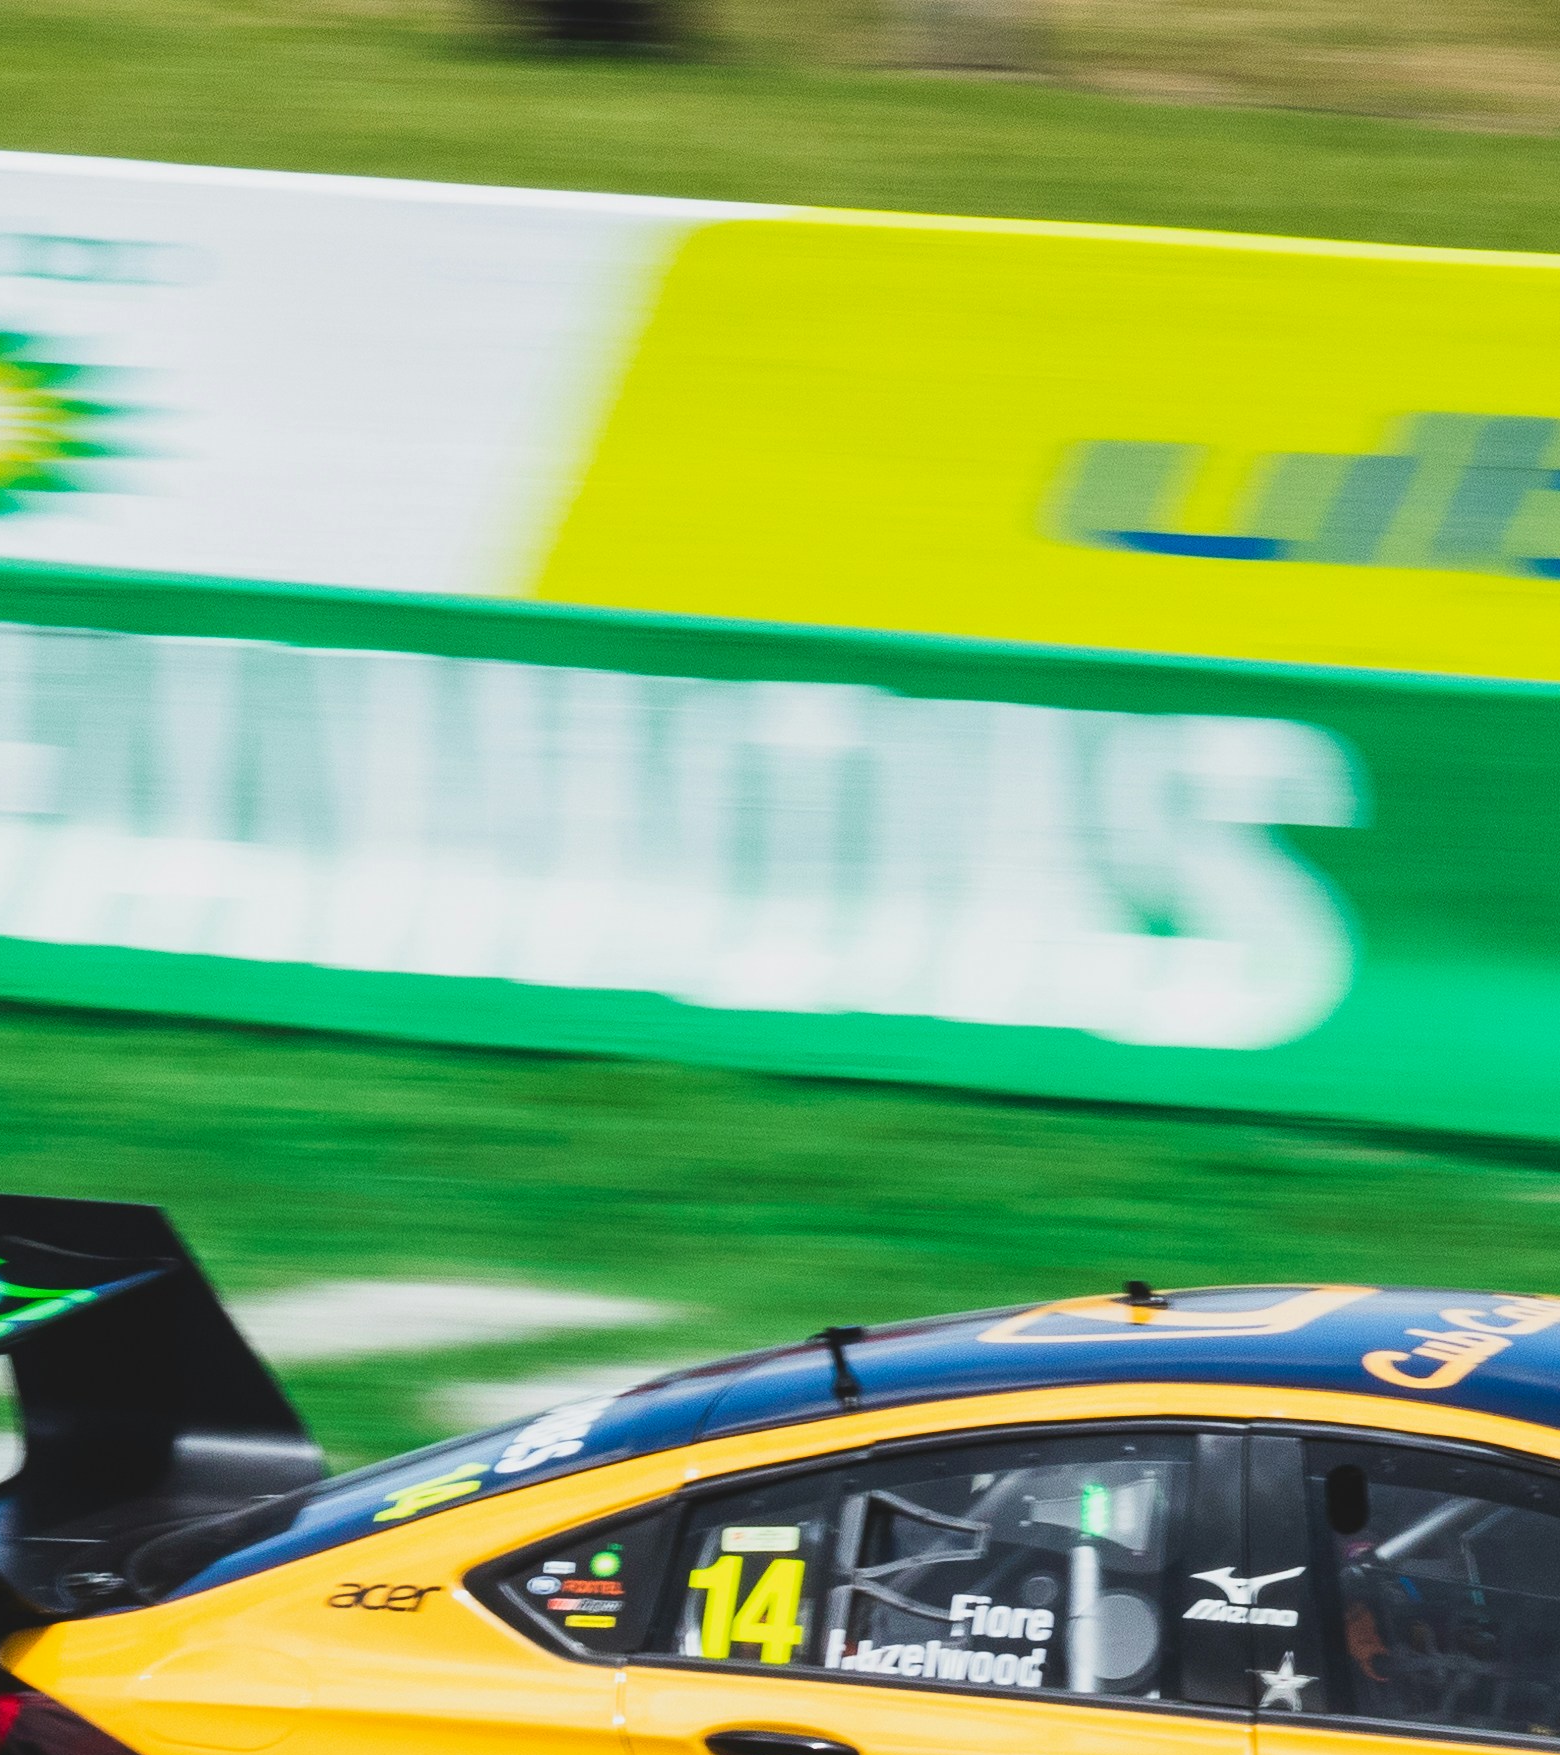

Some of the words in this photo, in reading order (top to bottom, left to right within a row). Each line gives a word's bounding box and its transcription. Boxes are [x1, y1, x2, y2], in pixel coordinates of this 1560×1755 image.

[1361, 1328, 1513, 1389] Cub
[327, 1580, 442, 1613] acer
[688, 1555, 805, 1664] 14
[950, 1594, 1054, 1642] Fiore
